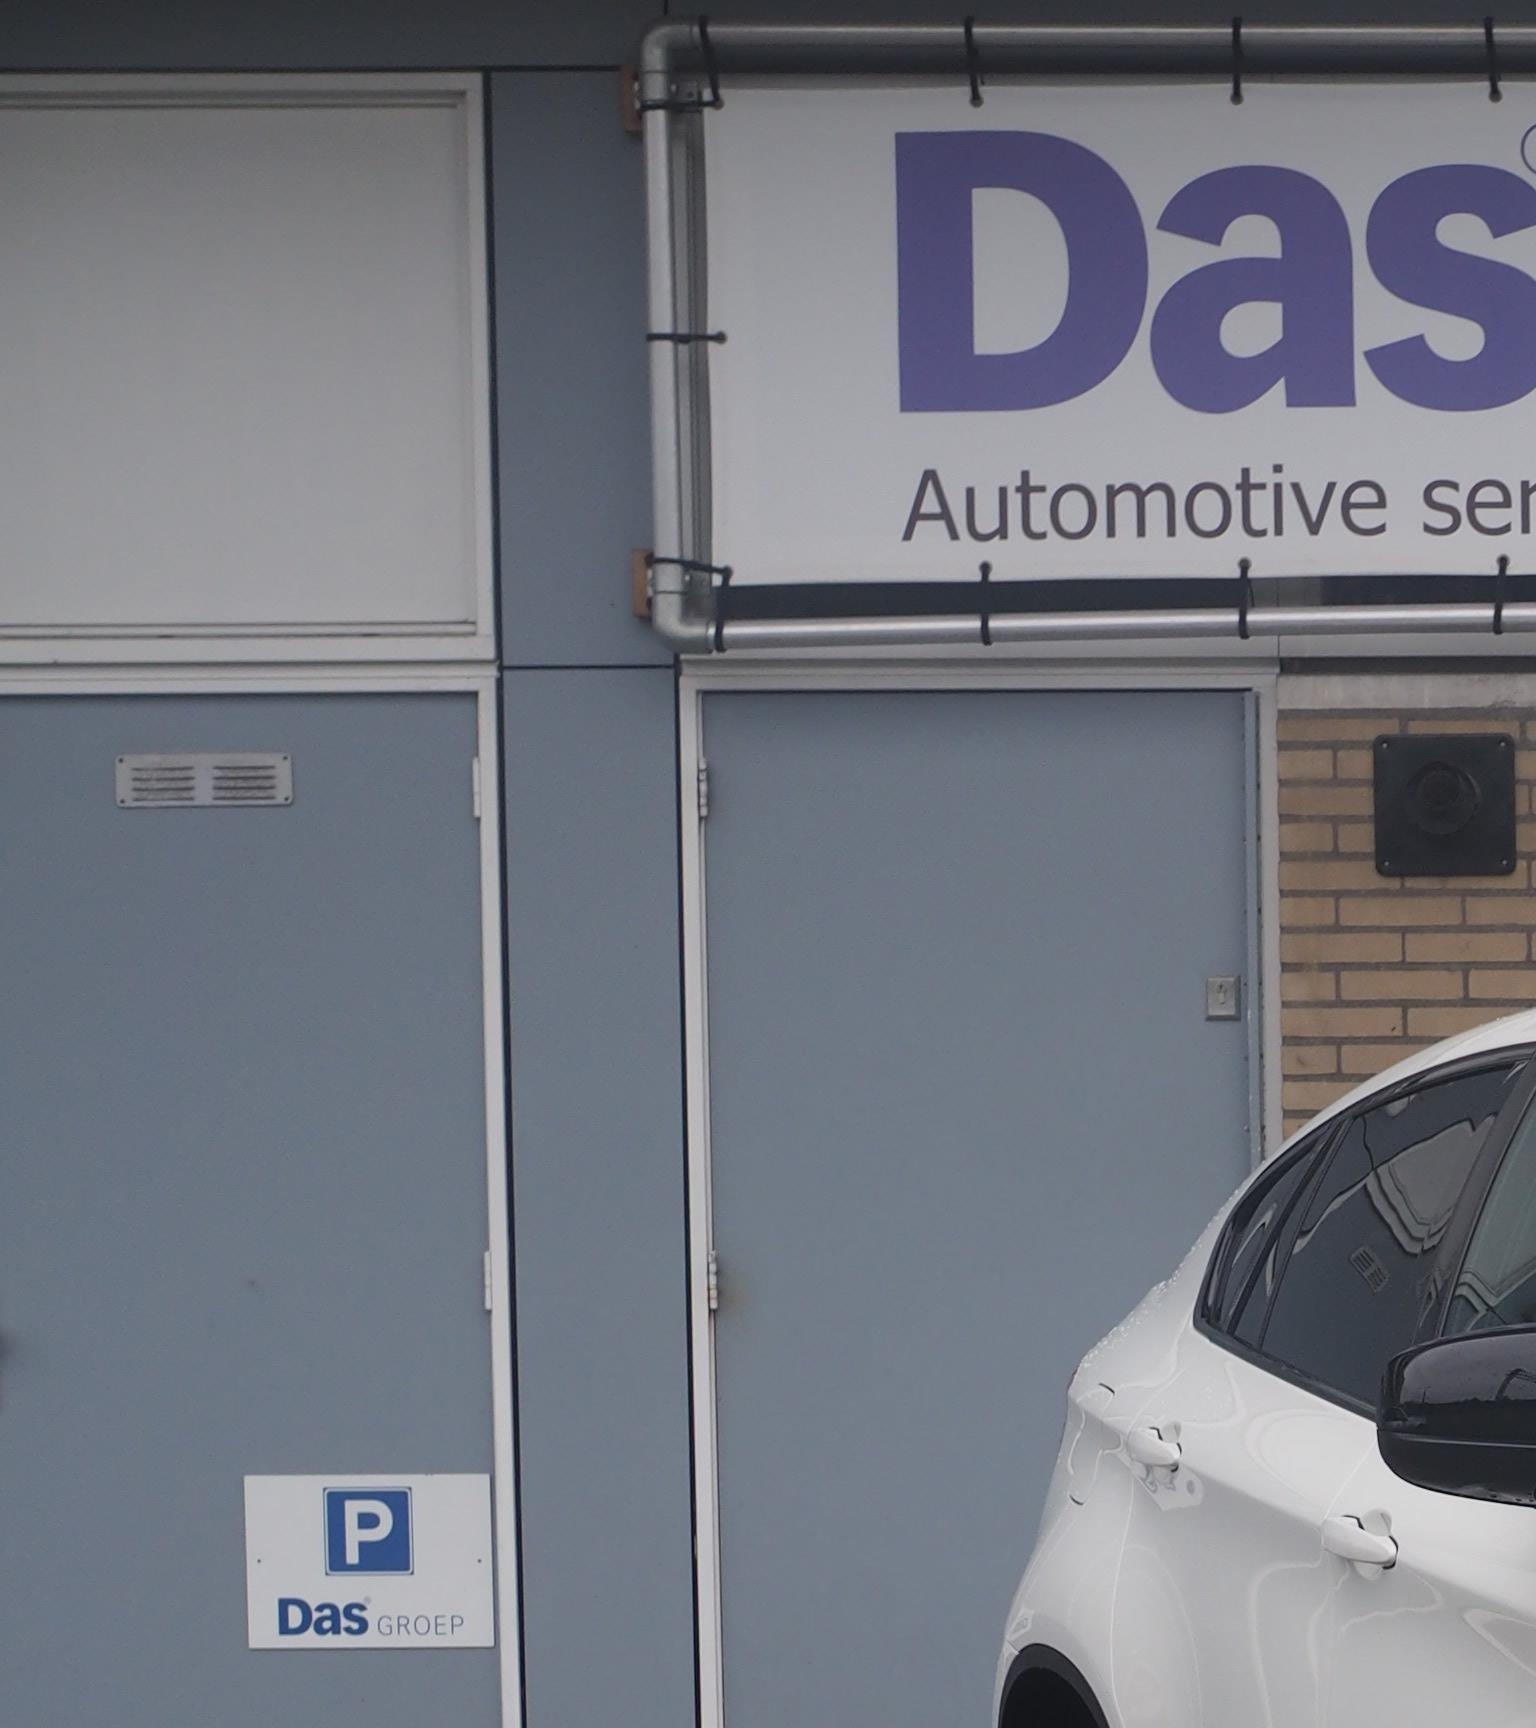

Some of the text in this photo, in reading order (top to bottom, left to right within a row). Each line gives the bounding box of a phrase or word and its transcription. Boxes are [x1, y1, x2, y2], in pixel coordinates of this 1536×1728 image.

[901, 463, 1388, 544] Automotive
[344, 1499, 394, 1565] P
[277, 1597, 465, 1636] Das GROEP
